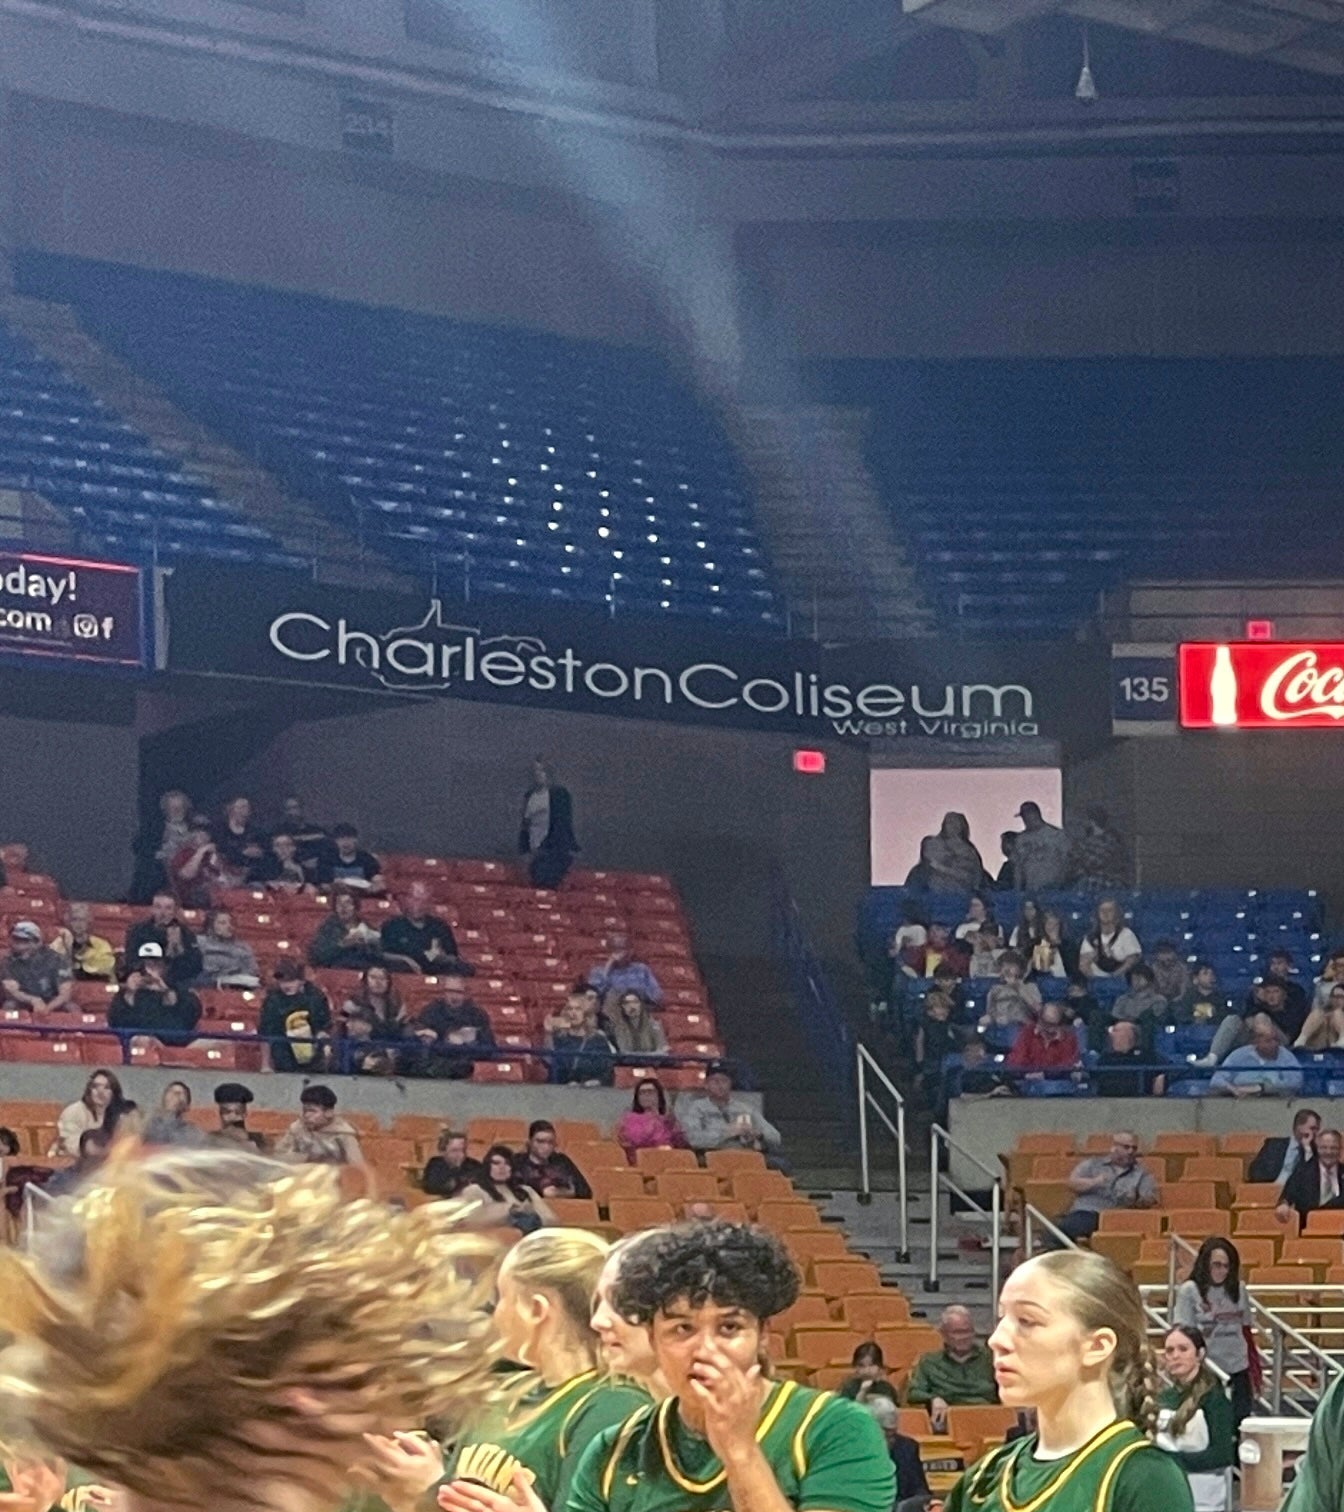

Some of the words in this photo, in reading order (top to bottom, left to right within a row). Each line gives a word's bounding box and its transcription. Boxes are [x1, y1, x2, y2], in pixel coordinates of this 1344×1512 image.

[0, 564, 77, 606] day!
[1119, 677, 1169, 701] 135
[833, 720, 907, 736] West
[920, 719, 1038, 739] Virginia
